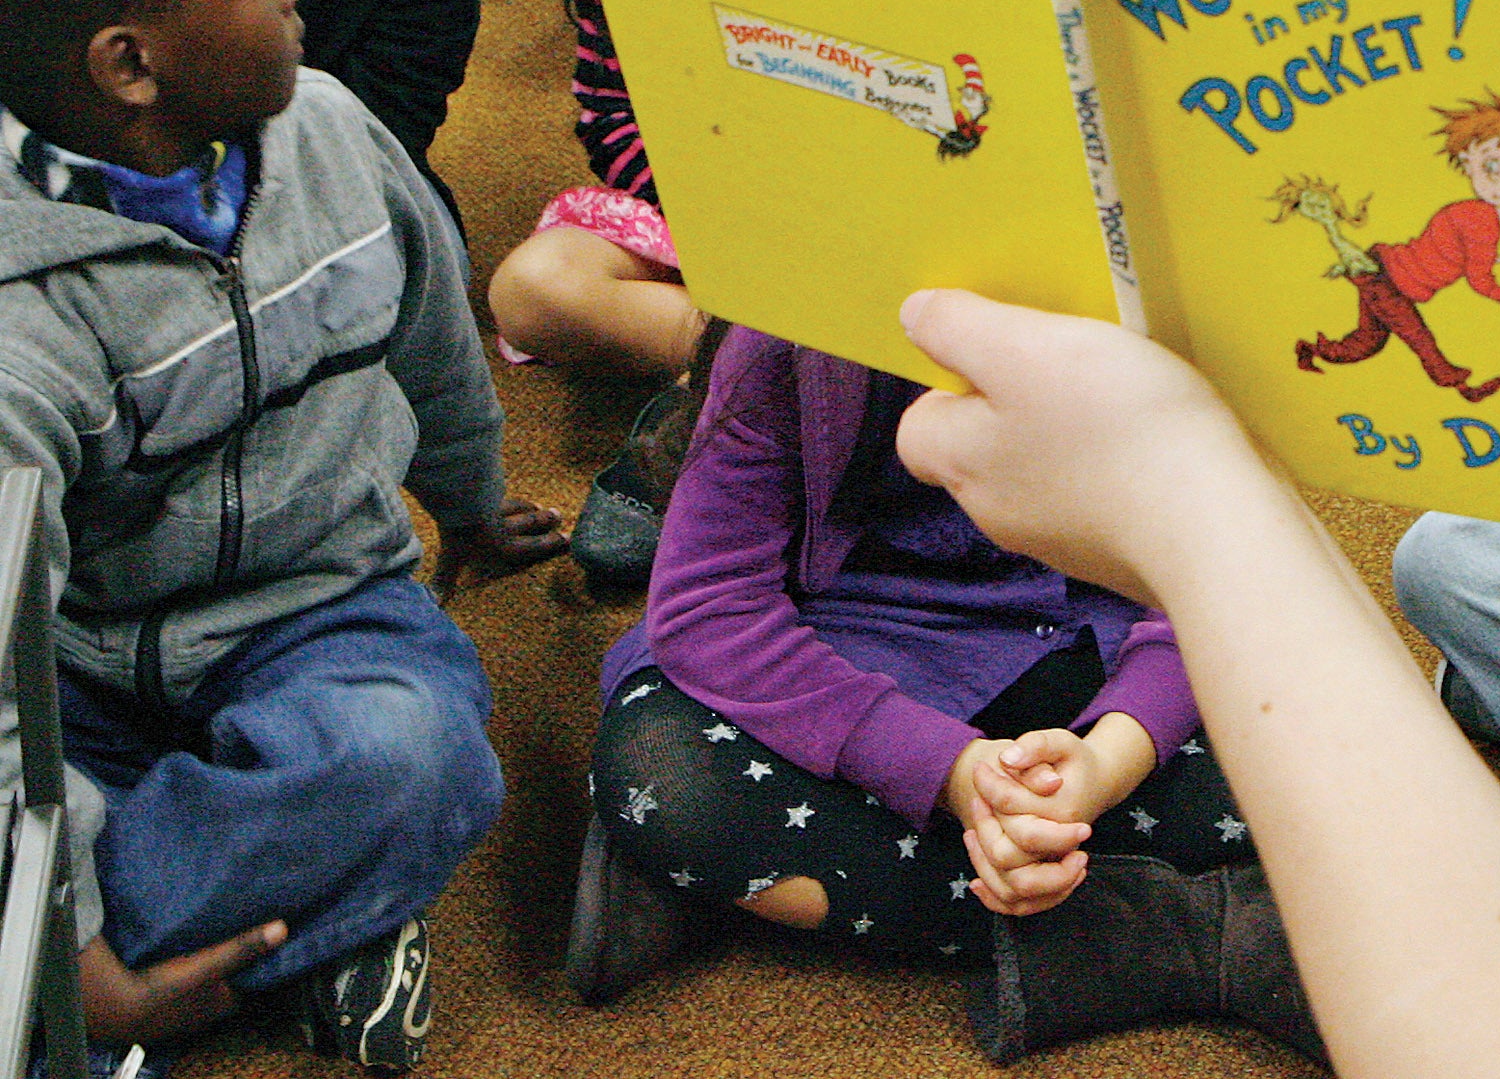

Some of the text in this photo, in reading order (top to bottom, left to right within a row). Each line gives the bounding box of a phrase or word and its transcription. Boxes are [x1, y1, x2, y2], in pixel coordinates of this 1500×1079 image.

[725, 23, 796, 51] BRIGHT
[816, 43, 876, 79] EARLY
[1243, 13, 1290, 46] in
[1337, 412, 1423, 470] By
